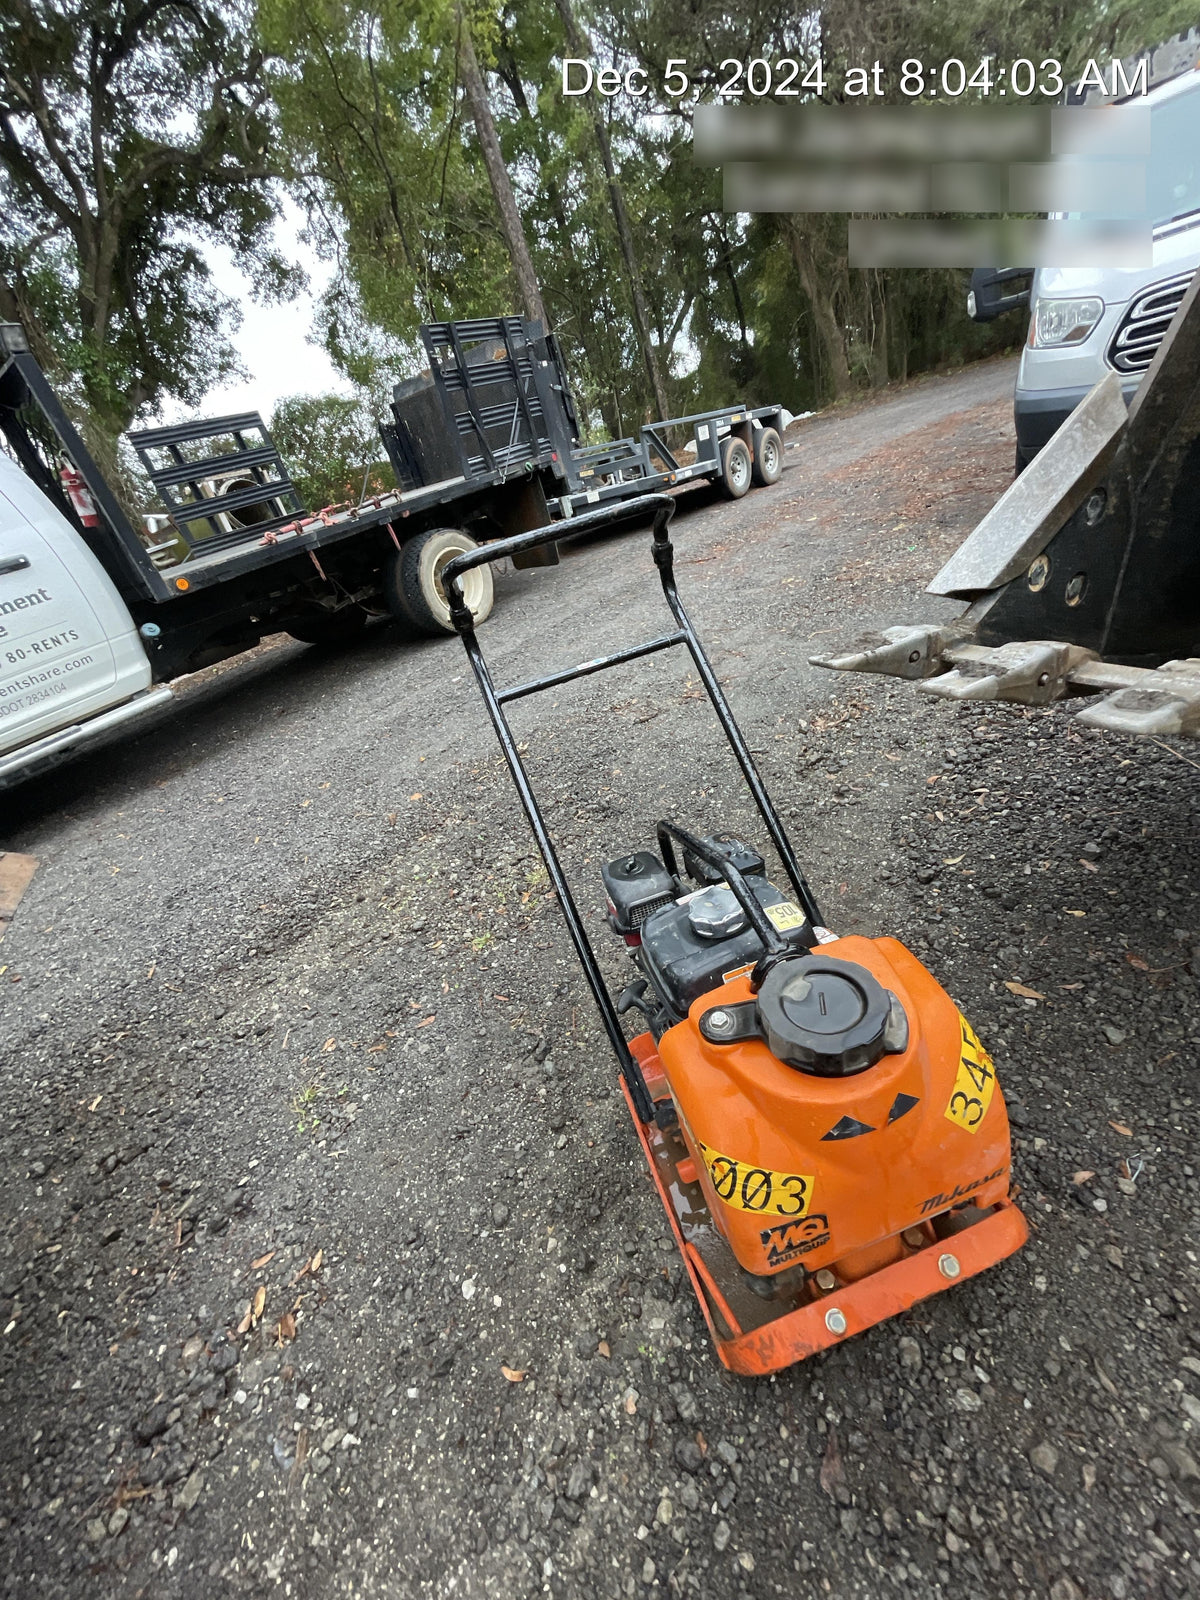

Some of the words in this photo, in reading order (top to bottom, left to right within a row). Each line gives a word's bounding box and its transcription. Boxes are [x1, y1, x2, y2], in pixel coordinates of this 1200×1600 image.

[5, 629, 79, 664] 80-RENTS
[0, 655, 93, 697] entshare.com
[26, 682, 67, 706] 2834104
[700, 1142, 807, 1216] 003
[760, 1214, 829, 1260] MQ
[769, 1235, 831, 1268] MULTIQUIP
